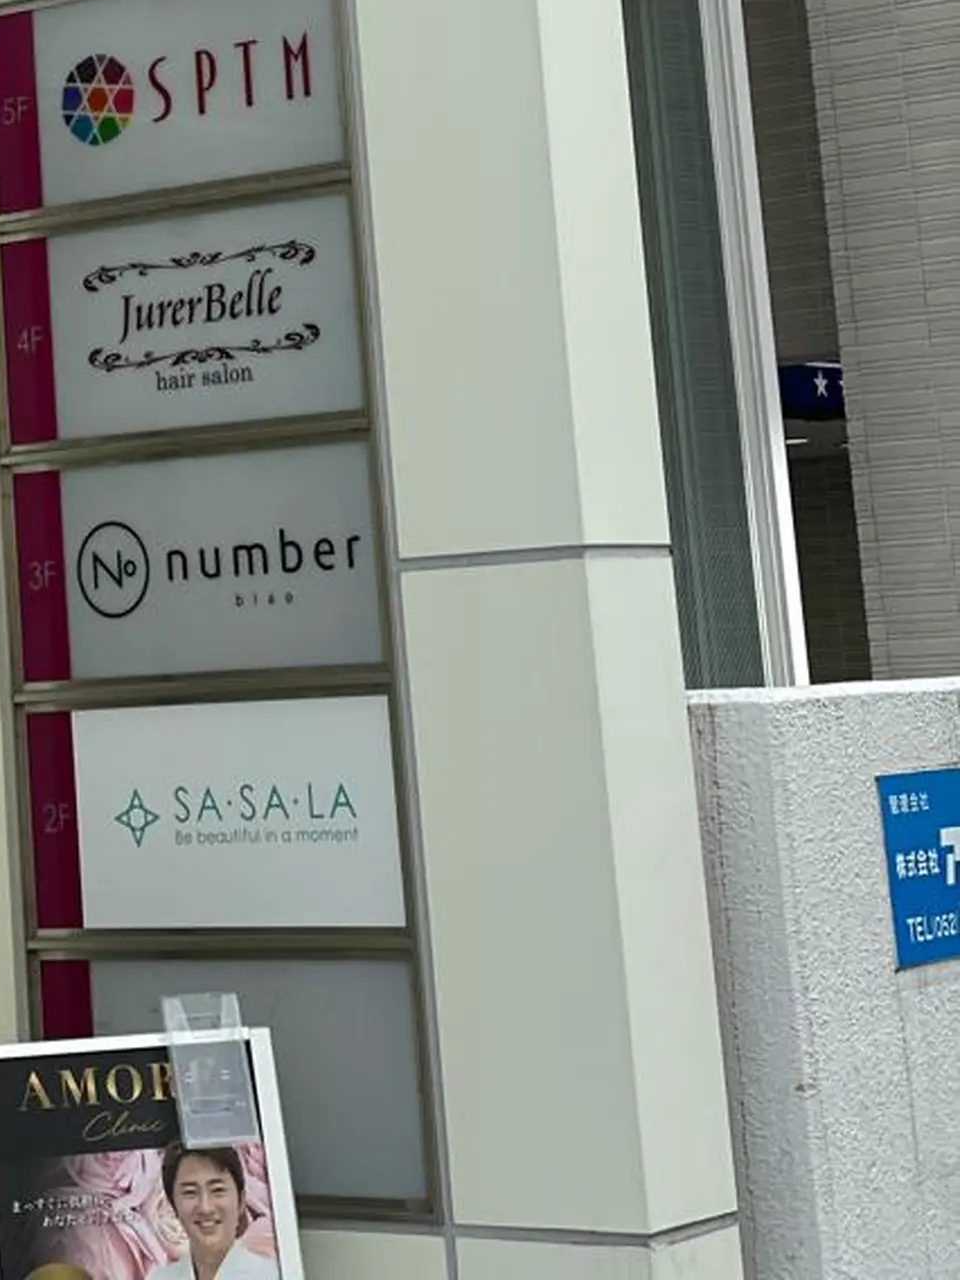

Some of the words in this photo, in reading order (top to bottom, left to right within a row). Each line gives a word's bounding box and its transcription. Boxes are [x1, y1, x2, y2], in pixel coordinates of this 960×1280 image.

[147, 29, 312, 124] SPTM
[2, 95, 32, 125] 5F
[118, 267, 284, 344] JurerBelle
[16, 325, 44, 353] 4F
[155, 369, 196, 392] hair
[200, 362, 255, 388] salon
[166, 527, 361, 582] number
[175, 830, 193, 846] Be
[197, 827, 262, 845] beautiful
[265, 829, 279, 844] in
[282, 830, 292, 844] a
[296, 827, 358, 843] moment
